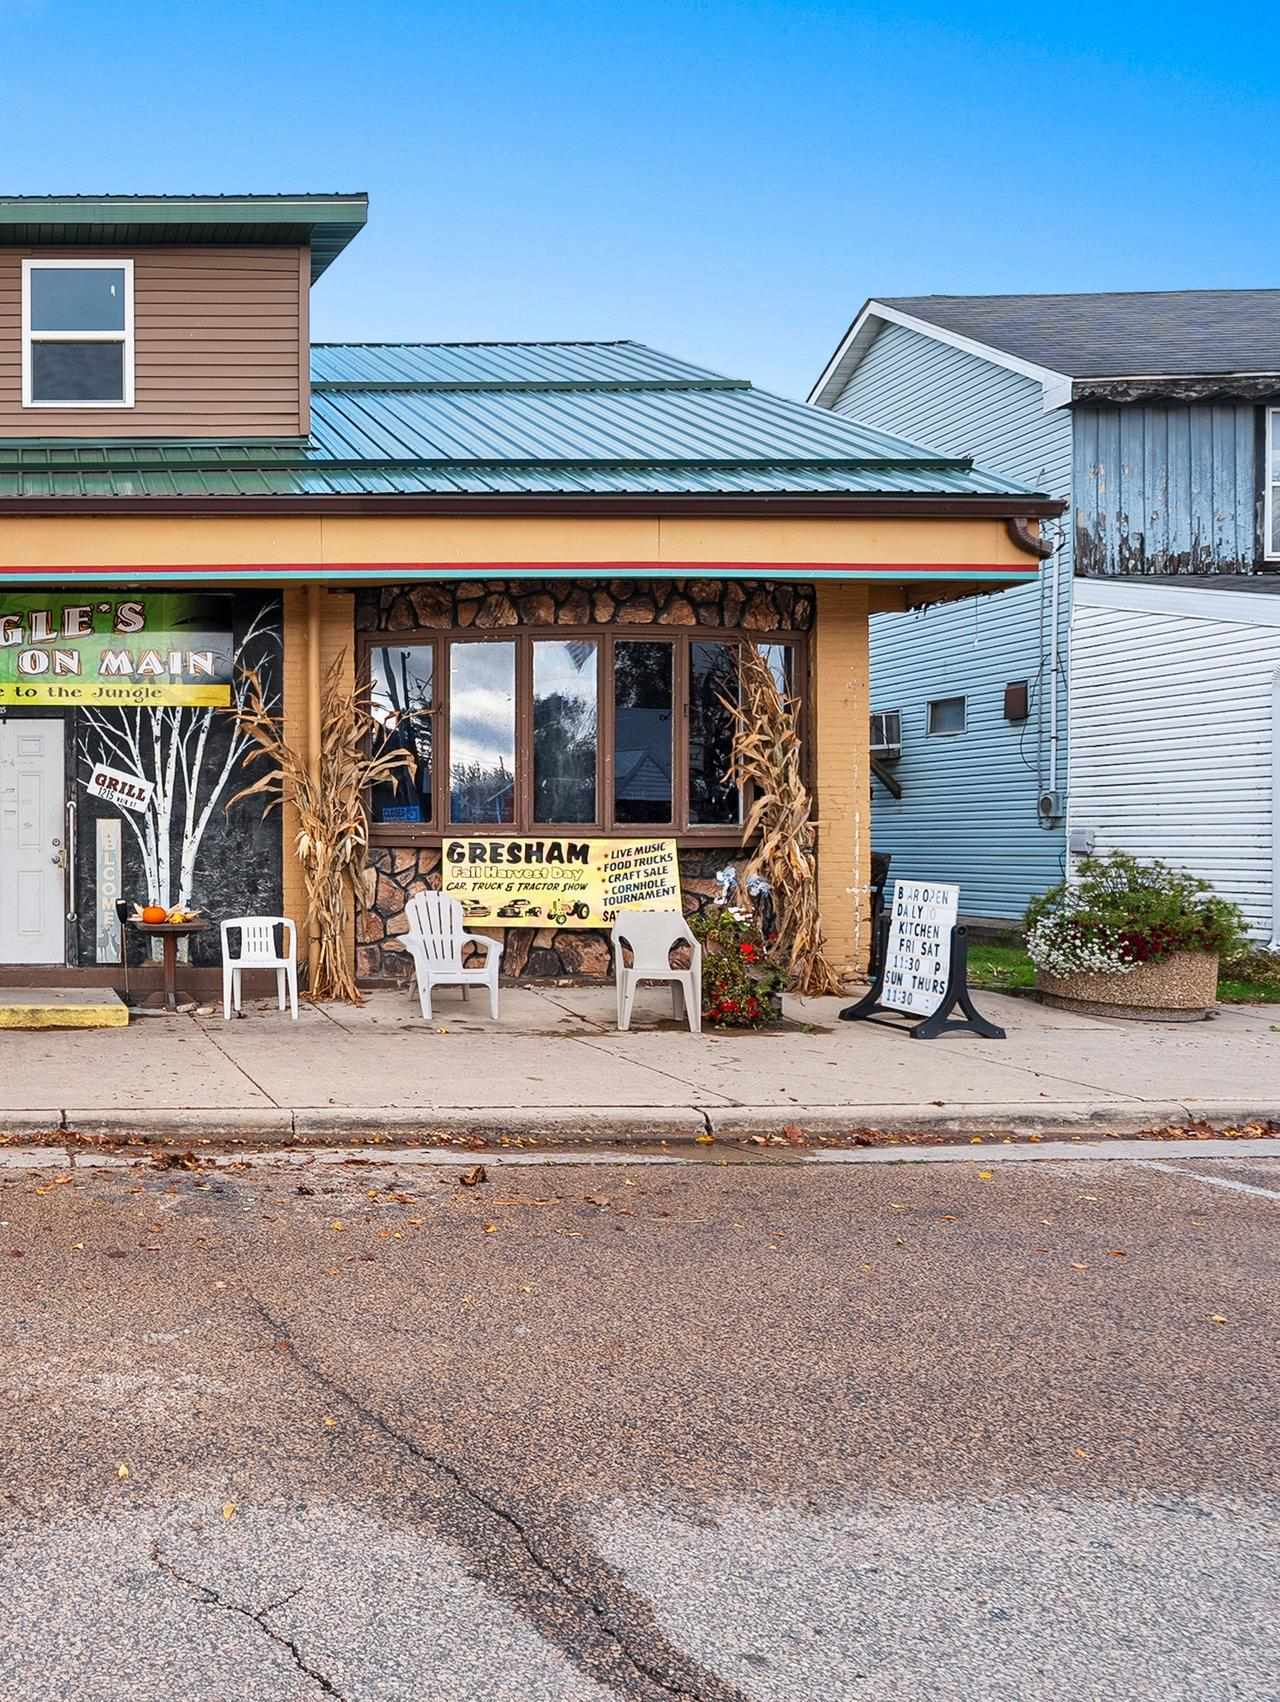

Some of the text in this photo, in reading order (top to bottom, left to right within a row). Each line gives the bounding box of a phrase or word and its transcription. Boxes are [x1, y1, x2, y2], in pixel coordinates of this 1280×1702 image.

[18, 650, 216, 677] ON MAIN
[15, 686, 38, 698] to
[48, 686, 83, 698] the
[92, 686, 164, 704] Jungle
[95, 773, 146, 802] GRILL
[98, 787, 115, 800] 1215
[446, 841, 590, 865] GRESHAM
[611, 842, 666, 859] LIVE MUSIC
[604, 853, 673, 872] FOOD TRUCKS
[452, 866, 584, 881] Fall Harvest Day
[608, 866, 669, 883] CRAFT SALE
[472, 882, 504, 891] TRUCK
[505, 882, 515, 892] &
[517, 882, 560, 892] TRACTOR
[561, 882, 589, 892] SHOW
[611, 878, 666, 895] CORNHOLE
[602, 885, 677, 906] TOURNAMENT
[602, 910, 620, 922] SA
[897, 903, 924, 919] DALY
[899, 921, 940, 938] KITCHEN
[899, 938, 940, 957] FRI SAT
[893, 955, 920, 972] 11:30
[885, 971, 945, 995] SUN THURS
[886, 989, 913, 1005] 11:30
